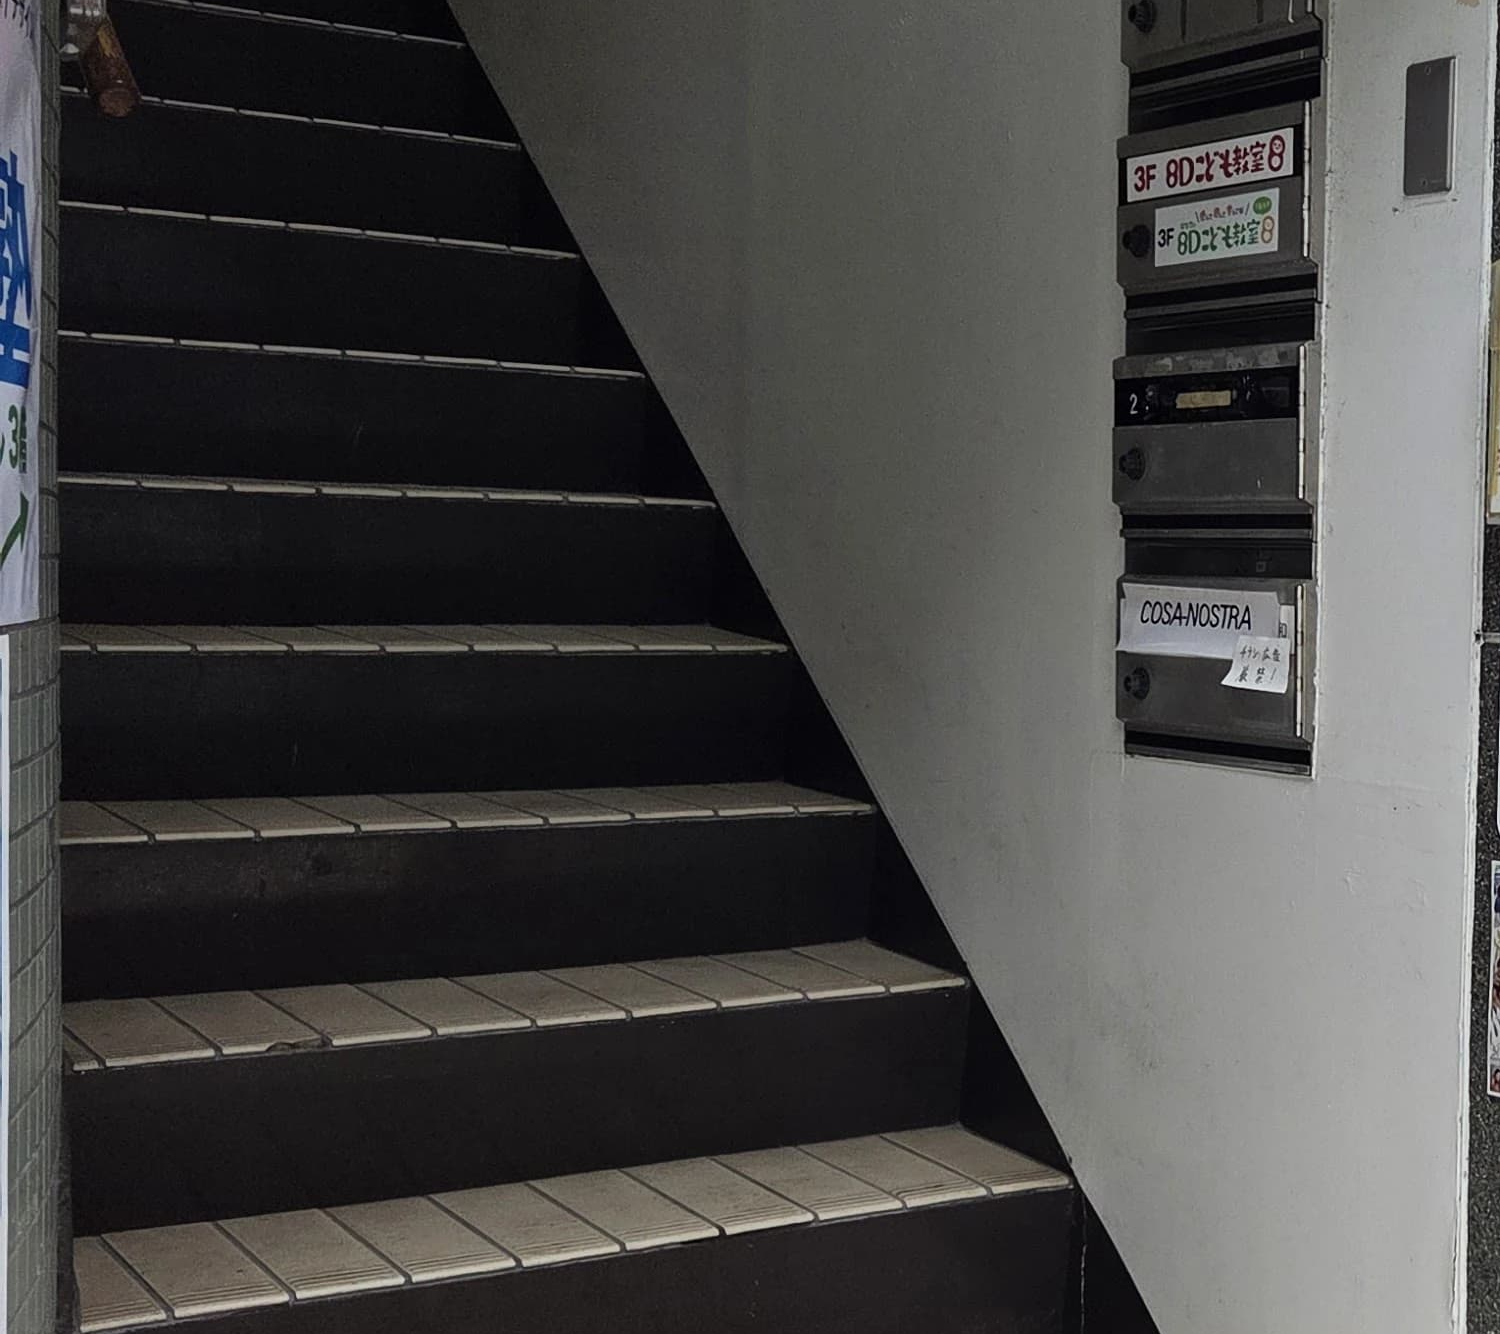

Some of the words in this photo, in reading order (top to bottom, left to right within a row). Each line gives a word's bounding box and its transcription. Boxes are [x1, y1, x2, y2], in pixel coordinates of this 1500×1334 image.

[1134, 163, 1157, 193] 3F
[1165, 140, 1266, 189] 8Dこども教室
[1158, 226, 1174, 248] 3F
[1177, 218, 1261, 256] 8Dこども教室
[1140, 600, 1252, 632] COSA-NOSTRA
